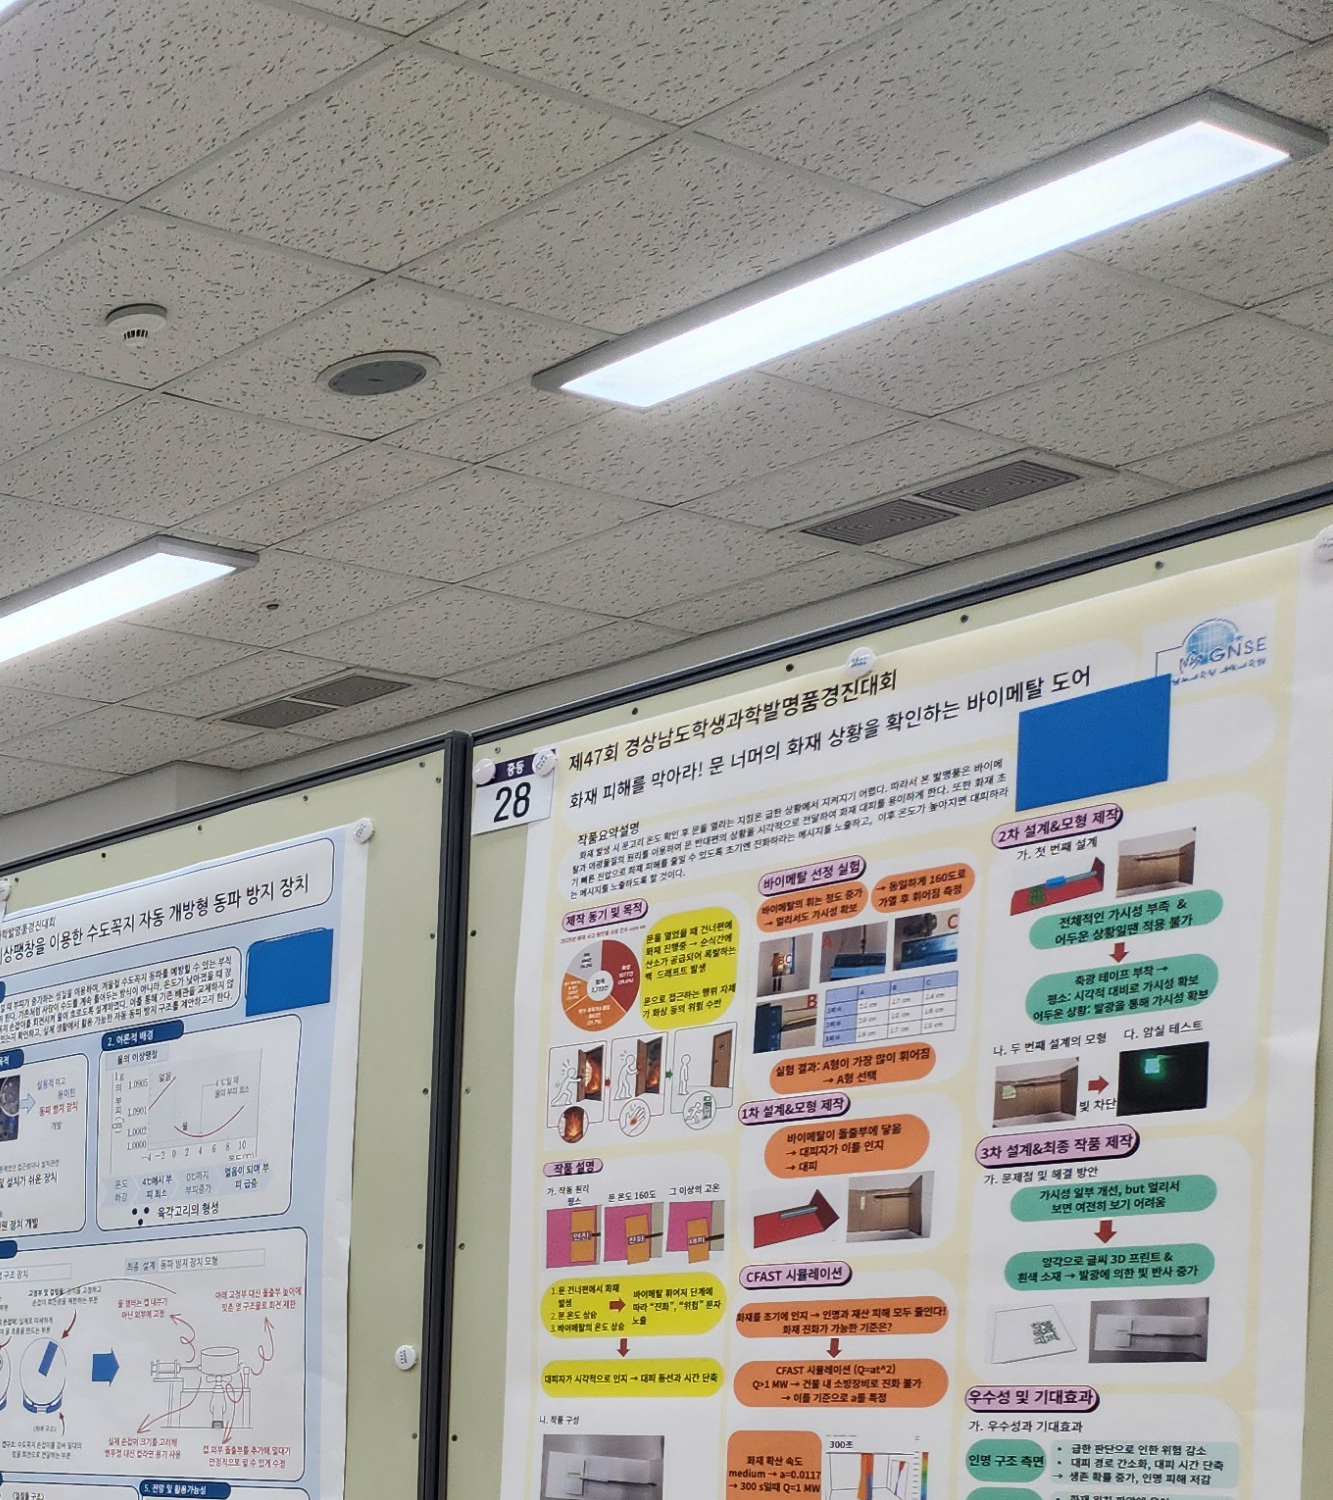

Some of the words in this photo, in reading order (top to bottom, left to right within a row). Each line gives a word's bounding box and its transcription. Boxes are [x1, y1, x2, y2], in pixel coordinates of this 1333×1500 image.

[568, 741, 618, 771] 제47회
[624, 668, 896, 757] 경상남도학생과학발명품경진대회
[569, 786, 597, 808] 화재
[602, 774, 645, 800] 피해를
[651, 761, 702, 788] 막아라!
[708, 755, 724, 775] 문
[730, 740, 780, 769] 너머의
[786, 731, 821, 755] 화재
[827, 718, 879, 747] 상황을
[885, 700, 960, 731] 확인하는
[966, 676, 1044, 712] 바이메탈
[1050, 664, 1089, 692] 도어
[492, 780, 532, 823] 28
[997, 826, 1019, 842] 2차
[1023, 812, 1087, 838] 설계&모형
[1091, 804, 1120, 825] 제작
[762, 870, 807, 889] 바이메탈
[810, 864, 833, 881] 선정
[837, 858, 862, 880] 실험
[49, 927, 83, 950] 이용한
[86, 913, 134, 942] 수도꼭지
[138, 907, 164, 929] 자동
[168, 895, 208, 922] 개방형
[212, 888, 241, 913] 동파
[246, 880, 273, 905] 방지
[279, 872, 308, 897] 장치
[565, 912, 585, 926] 제작
[587, 907, 607, 923] 동기
[610, 905, 619, 919] 및
[622, 900, 644, 916] 목적
[740, 1104, 759, 1122] 1차
[762, 1099, 816, 1118] 설계&모형
[819, 1094, 845, 1113] 제작
[980, 1145, 1002, 1159] 3차
[1006, 1139, 1069, 1158] 설계&최종
[1073, 1136, 1101, 1152] 작품
[1105, 1131, 1134, 1150] 제작
[746, 1270, 782, 1282] CFAST
[785, 1266, 842, 1281] 시뮬레이션
[967, 1388, 1010, 1406] 우수성
[1015, 1389, 1028, 1404] 및
[1033, 1388, 1095, 1406] 기대효과
[968, 1420, 983, 1432] 가.
[987, 1420, 1032, 1432] 우수성과
[1036, 1420, 1083, 1433] 기대효과
[968, 1453, 991, 1466] 인명
[993, 1455, 1017, 1467] 구조
[1020, 1455, 1043, 1468] 측면
